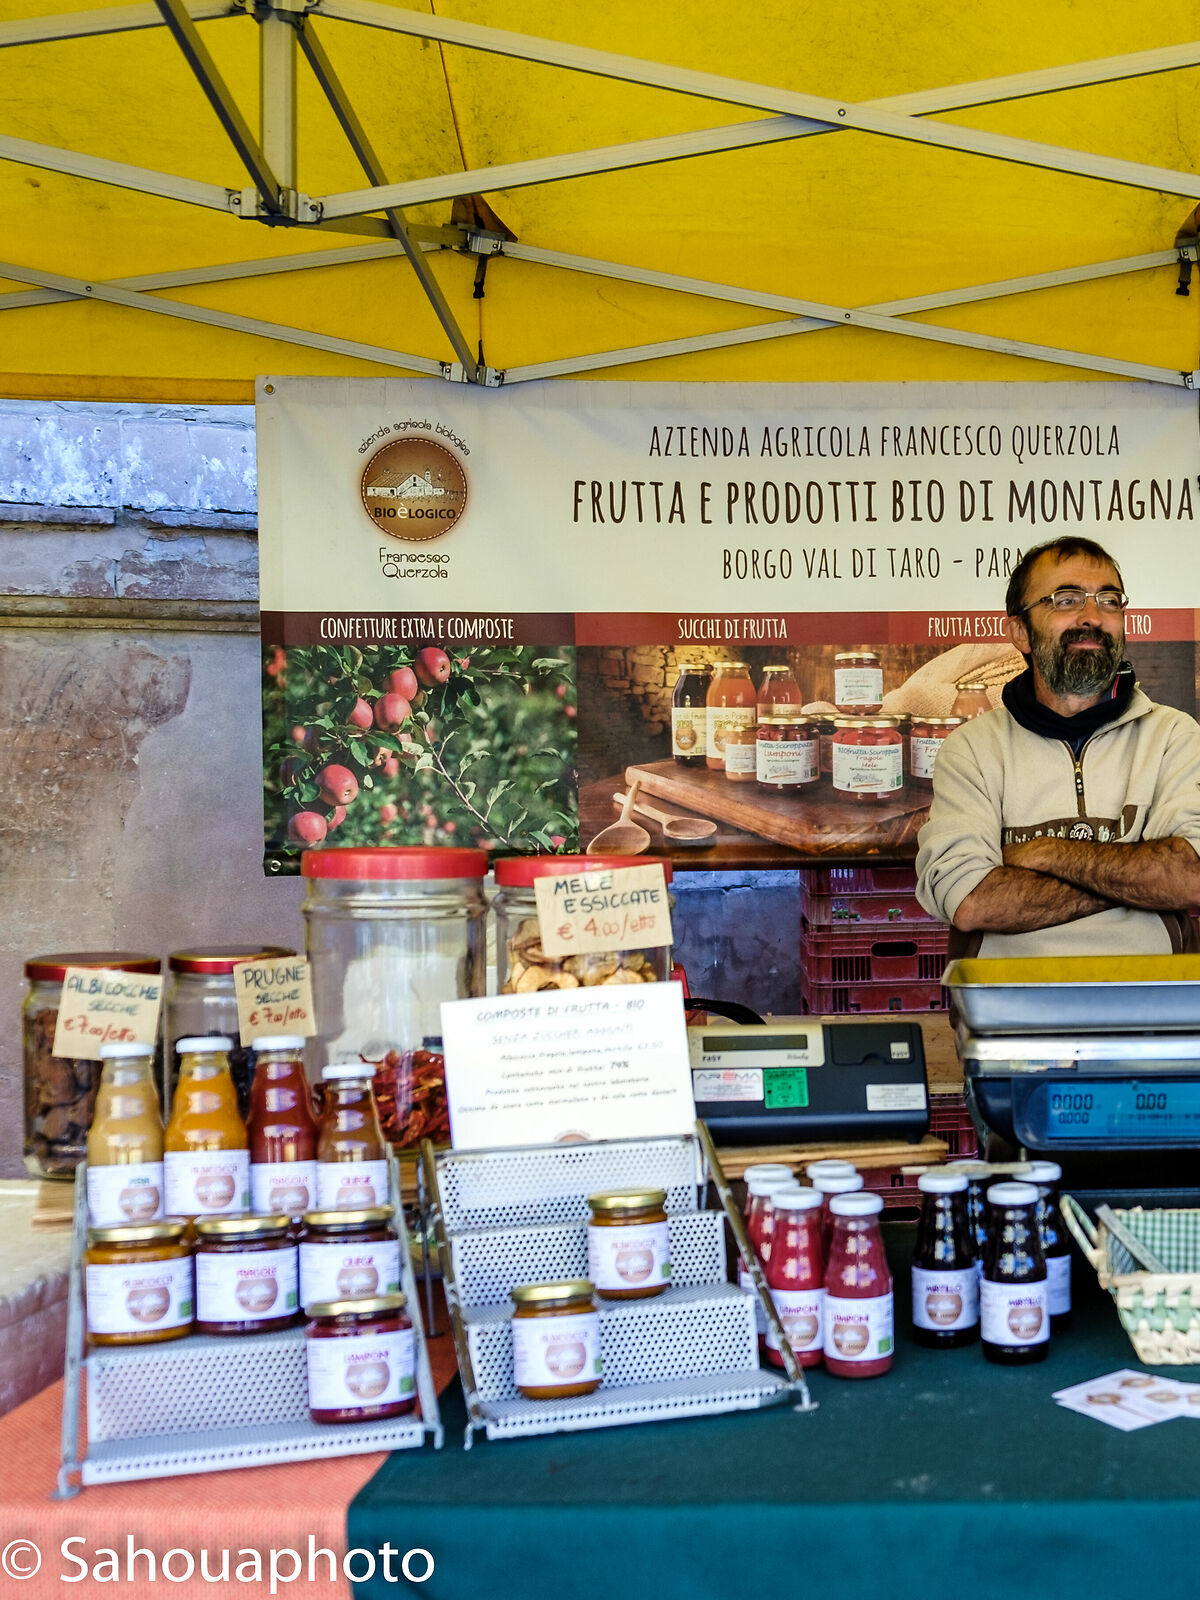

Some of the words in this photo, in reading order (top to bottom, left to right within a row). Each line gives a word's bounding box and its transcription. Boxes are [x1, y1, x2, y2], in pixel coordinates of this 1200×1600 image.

[358, 426, 391, 455] azienda
[393, 418, 432, 432] agricola
[435, 423, 471, 457] biologica
[649, 426, 750, 457] AZIENDA
[760, 426, 871, 457] AGRICOLA
[881, 425, 1001, 456] FRANCESCO
[1012, 425, 1120, 464] QUERZOLA
[573, 480, 686, 524] FRUTTA
[700, 481, 712, 525] E
[727, 480, 877, 525] PRODOTTI
[892, 479, 945, 523] BIO
[959, 480, 994, 523] DI
[1008, 478, 1194, 525] MONTAGNA
[379, 547, 451, 563] Francesco
[723, 548, 792, 580] BORGO
[803, 548, 842, 579] VAL
[852, 548, 877, 578] DI
[887, 547, 940, 579] TARO
[975, 547, 1023, 578] PAR
[382, 563, 449, 579] Querzola
[320, 617, 398, 639] CONFETTURE
[401, 617, 435, 639] EXTRA
[438, 618, 444, 639] E
[447, 617, 514, 640] COMPOSTE
[678, 618, 721, 639] SUCCHI
[725, 618, 740, 639] DI
[743, 618, 787, 639] FRUTTA
[928, 617, 972, 638] FRUTTA
[974, 616, 1006, 637] ESSIC
[1124, 614, 1152, 635] LTRO
[553, 875, 613, 895] MELE
[564, 889, 661, 913] ESSICCATE
[66, 972, 160, 1001] ALBICOCCHE
[243, 965, 306, 989] PRUGNE
[476, 1006, 542, 1022] COMPOSTE
